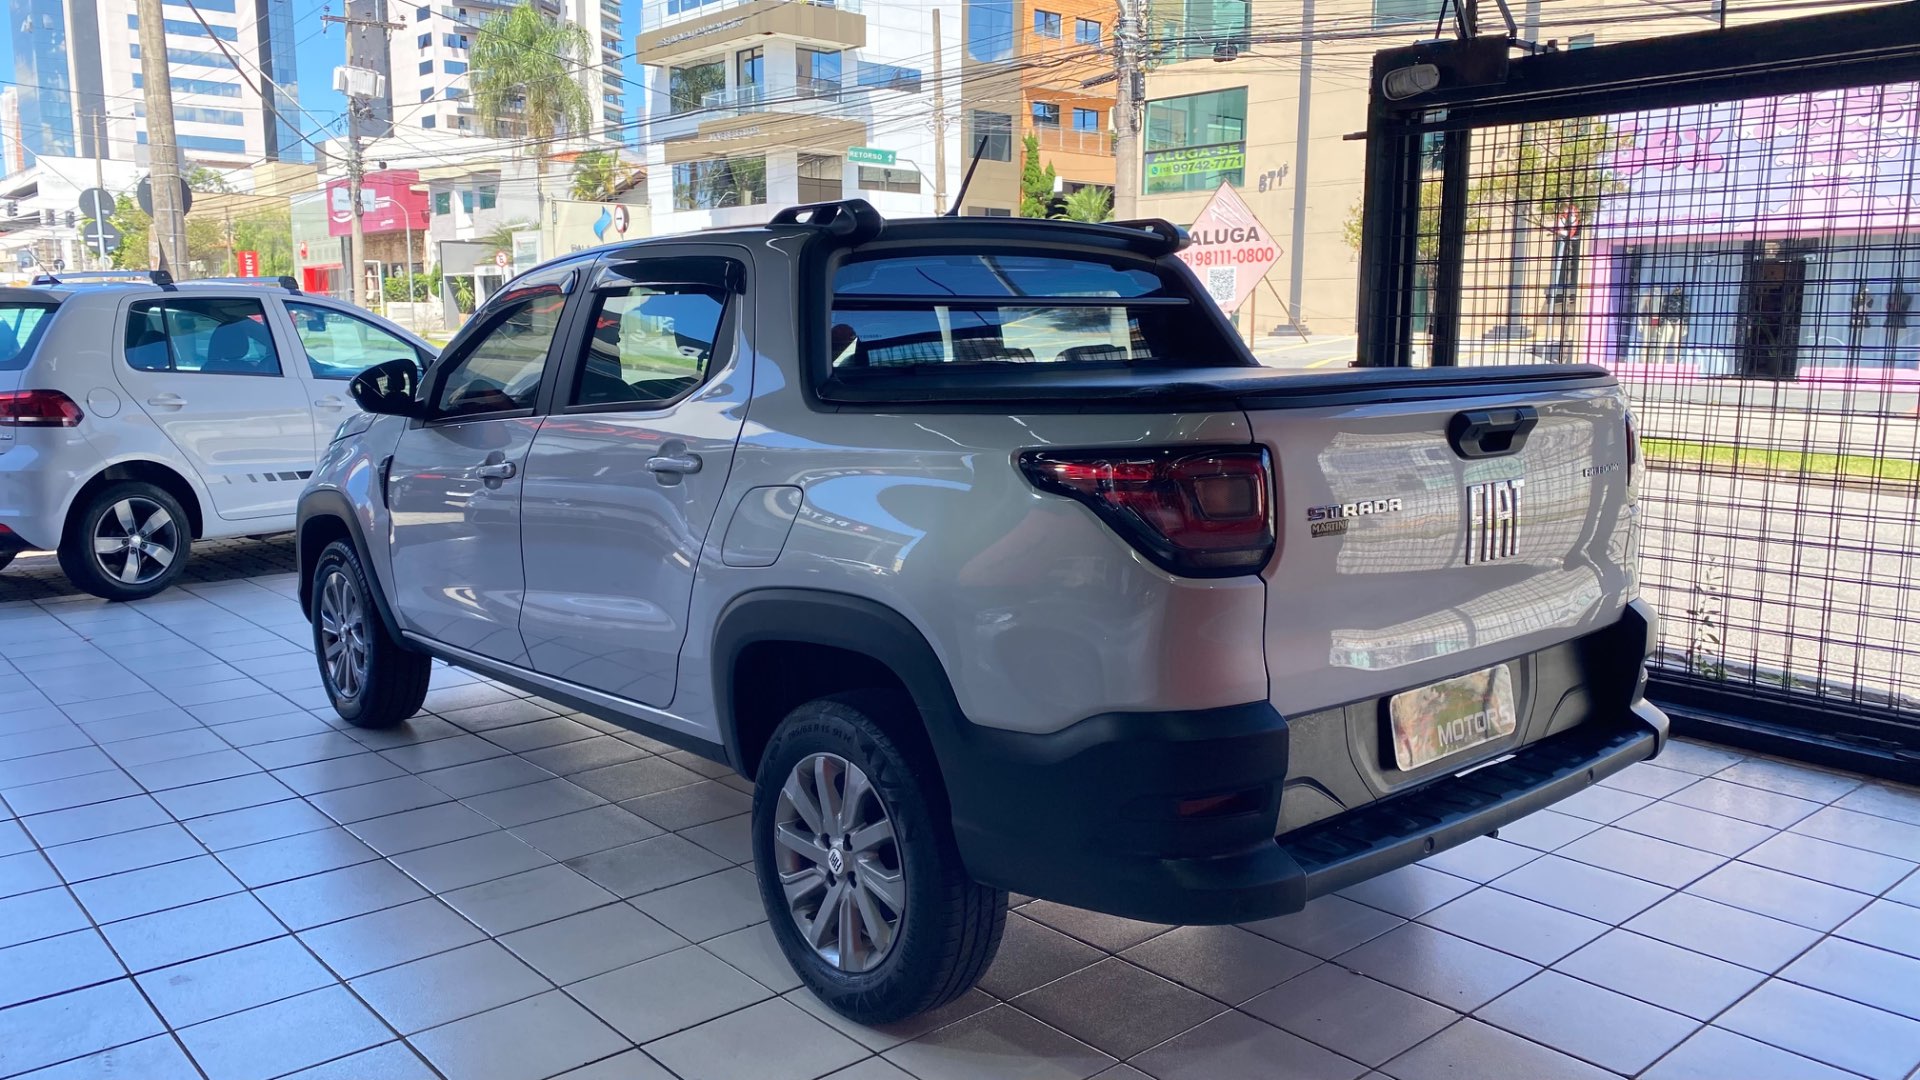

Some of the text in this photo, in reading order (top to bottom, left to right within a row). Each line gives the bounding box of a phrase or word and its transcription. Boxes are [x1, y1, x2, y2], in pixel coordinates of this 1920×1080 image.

[1154, 144, 1240, 162] ALUGA-SE
[1172, 156, 1242, 173] 99742-7771
[1191, 226, 1261, 246] ALUGA
[1195, 247, 1274, 266] 98111-0800
[1307, 498, 1403, 521] STRADA
[1466, 479, 1525, 565] FIAT
[1437, 705, 1511, 748] MOTORS
